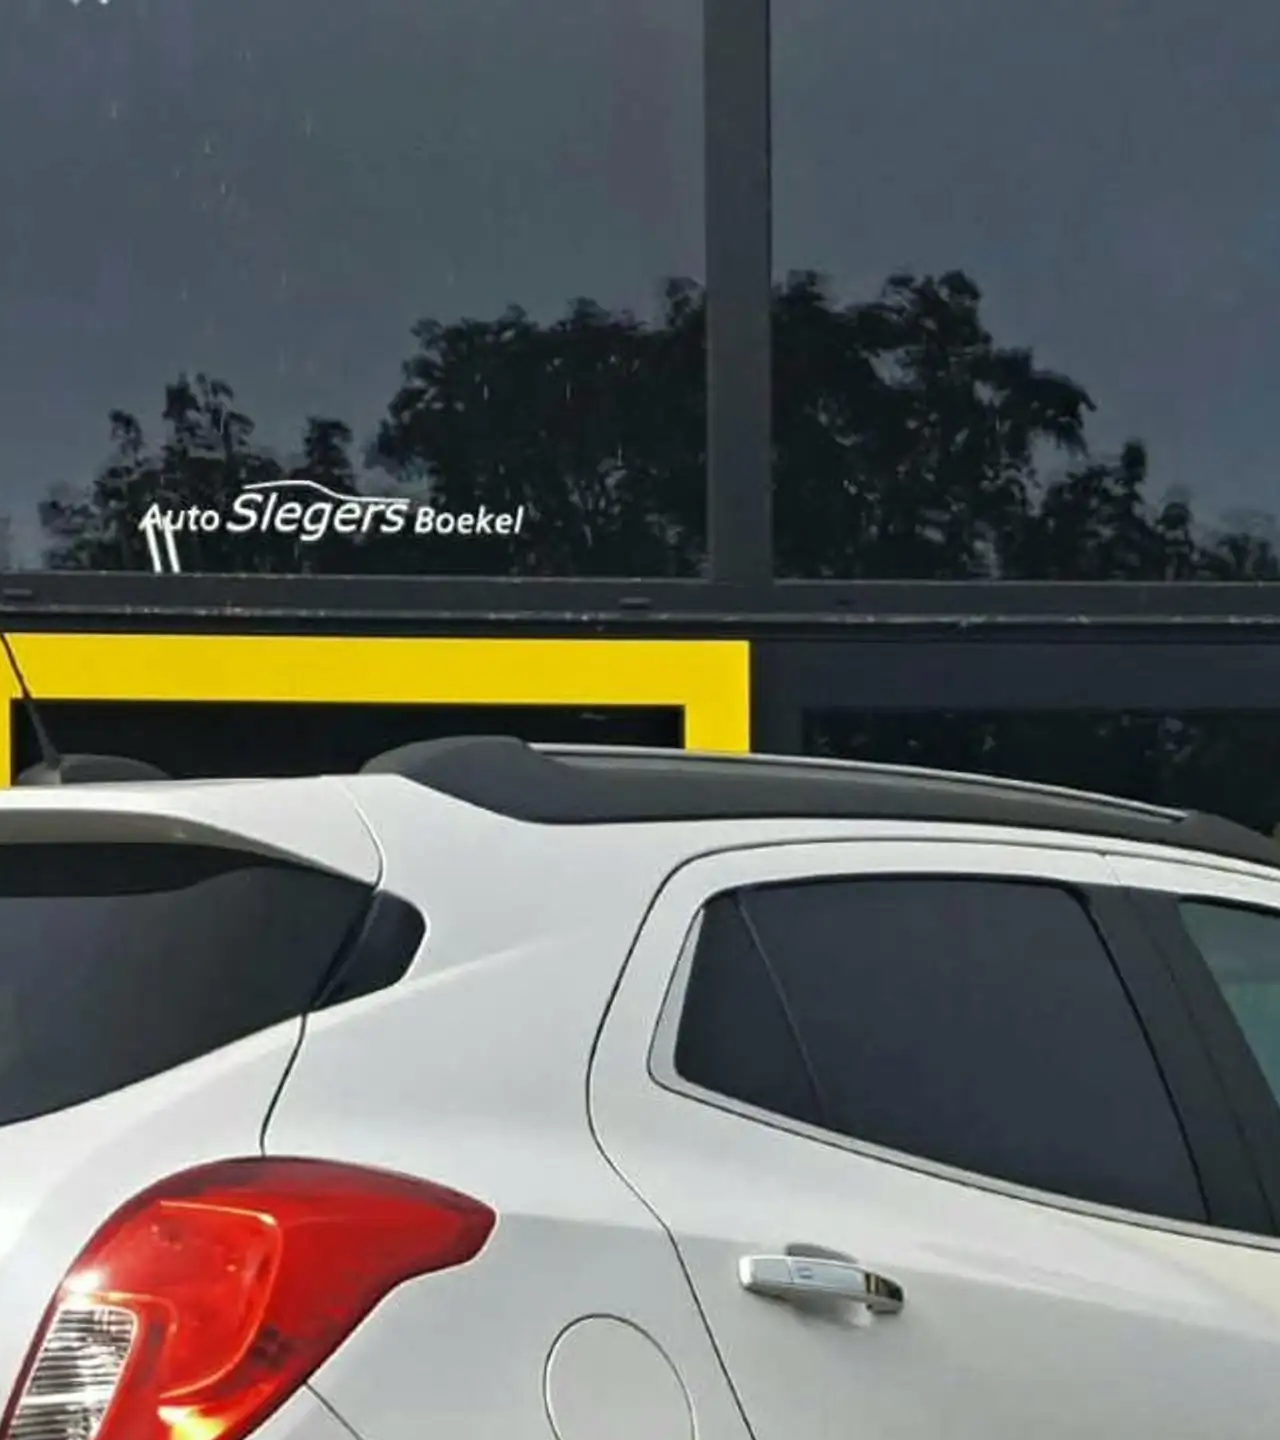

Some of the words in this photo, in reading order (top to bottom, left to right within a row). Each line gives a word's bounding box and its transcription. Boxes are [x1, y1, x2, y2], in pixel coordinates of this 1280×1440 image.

[138, 502, 220, 533] Auto
[225, 491, 408, 542] Slegers
[415, 505, 524, 535] Boekel
